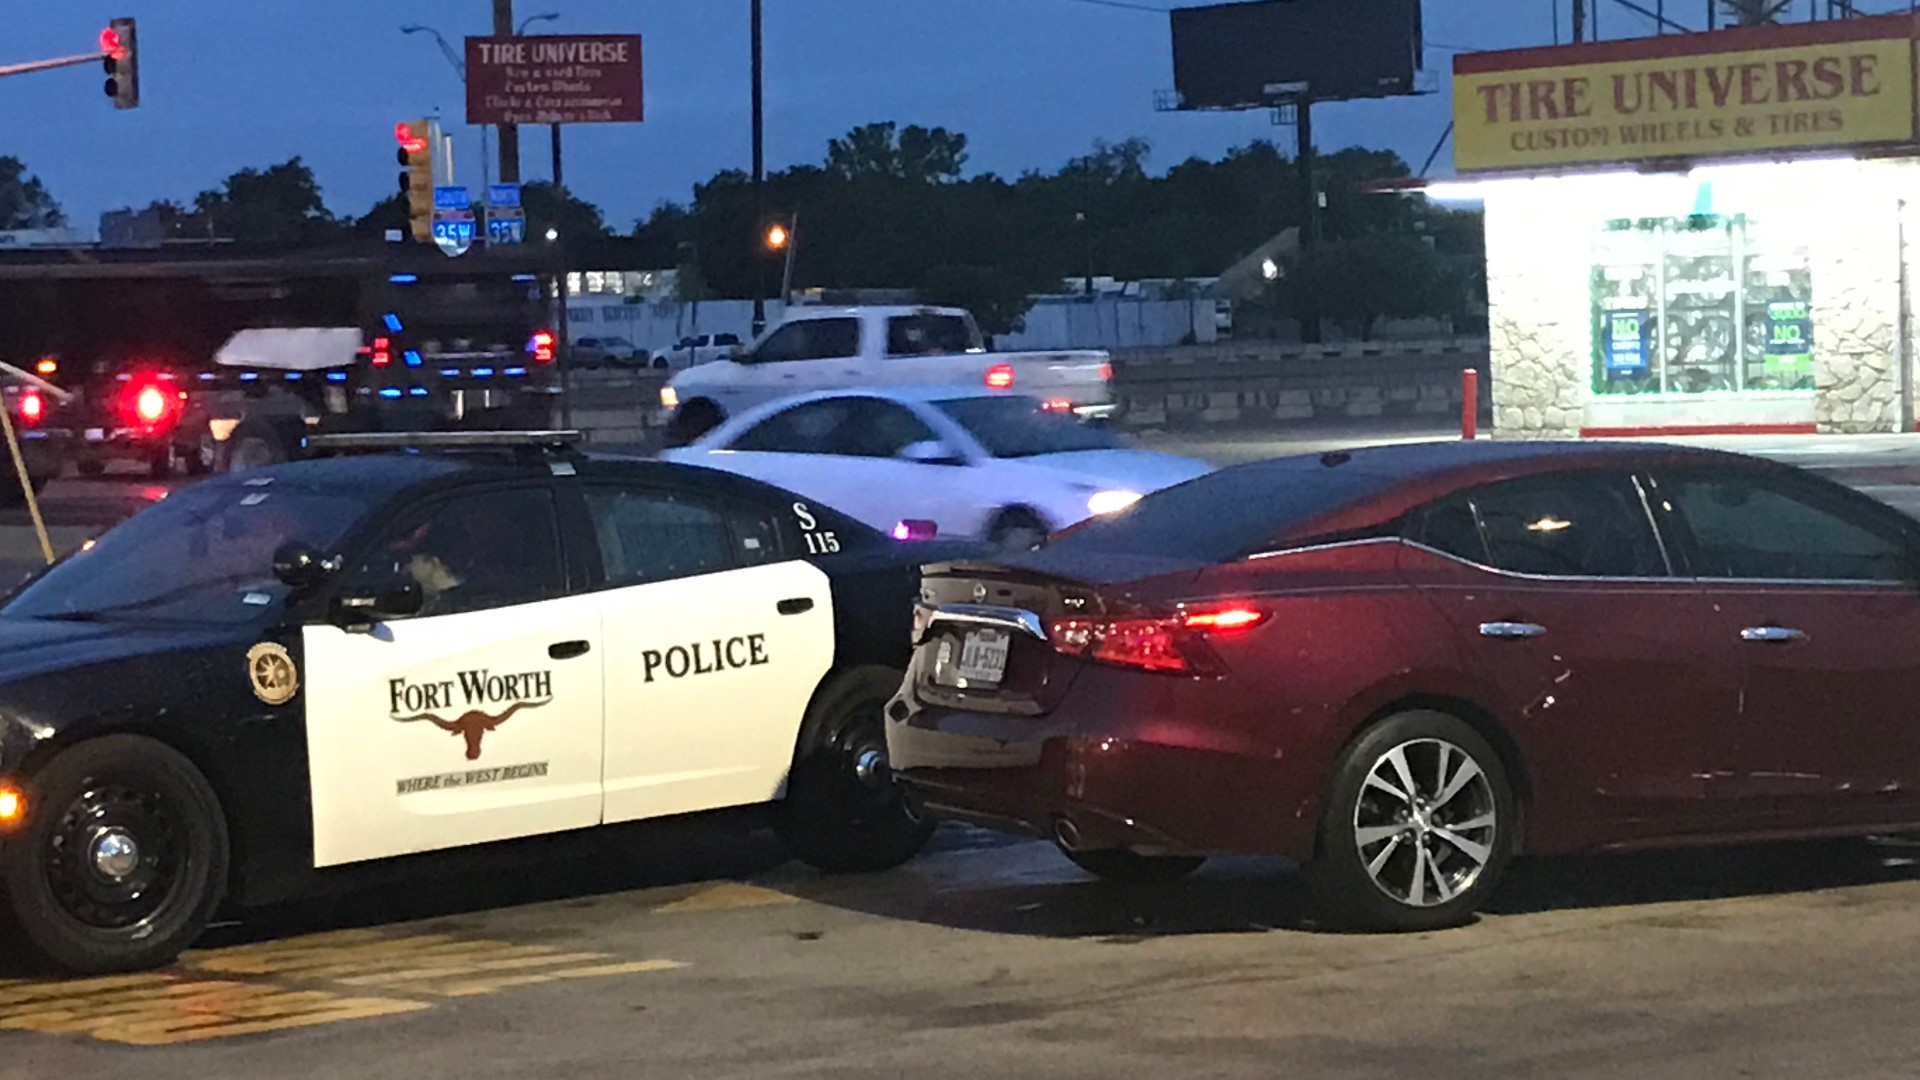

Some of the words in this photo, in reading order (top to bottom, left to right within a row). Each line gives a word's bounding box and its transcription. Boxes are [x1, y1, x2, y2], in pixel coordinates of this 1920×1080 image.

[479, 43, 526, 64] TIRE
[532, 42, 628, 63] UNIVERSE
[1477, 77, 1593, 124] TIRE
[1611, 53, 1881, 115] UNIVERSE
[1510, 127, 1610, 152] CUSTOM
[1619, 117, 1723, 145] WHEELS
[1734, 118, 1755, 137] &
[1769, 108, 1844, 135] TIRES
[1773, 325, 1801, 340] NO
[792, 502, 816, 531] S
[803, 531, 840, 554] 115
[641, 633, 769, 683] POLICE
[389, 677, 455, 713] FORT
[457, 669, 552, 705] WORTH
[396, 775, 441, 795] WHERE
[443, 774, 461, 787] the
[465, 768, 500, 784] WEST
[502, 762, 549, 780] BEGINS
